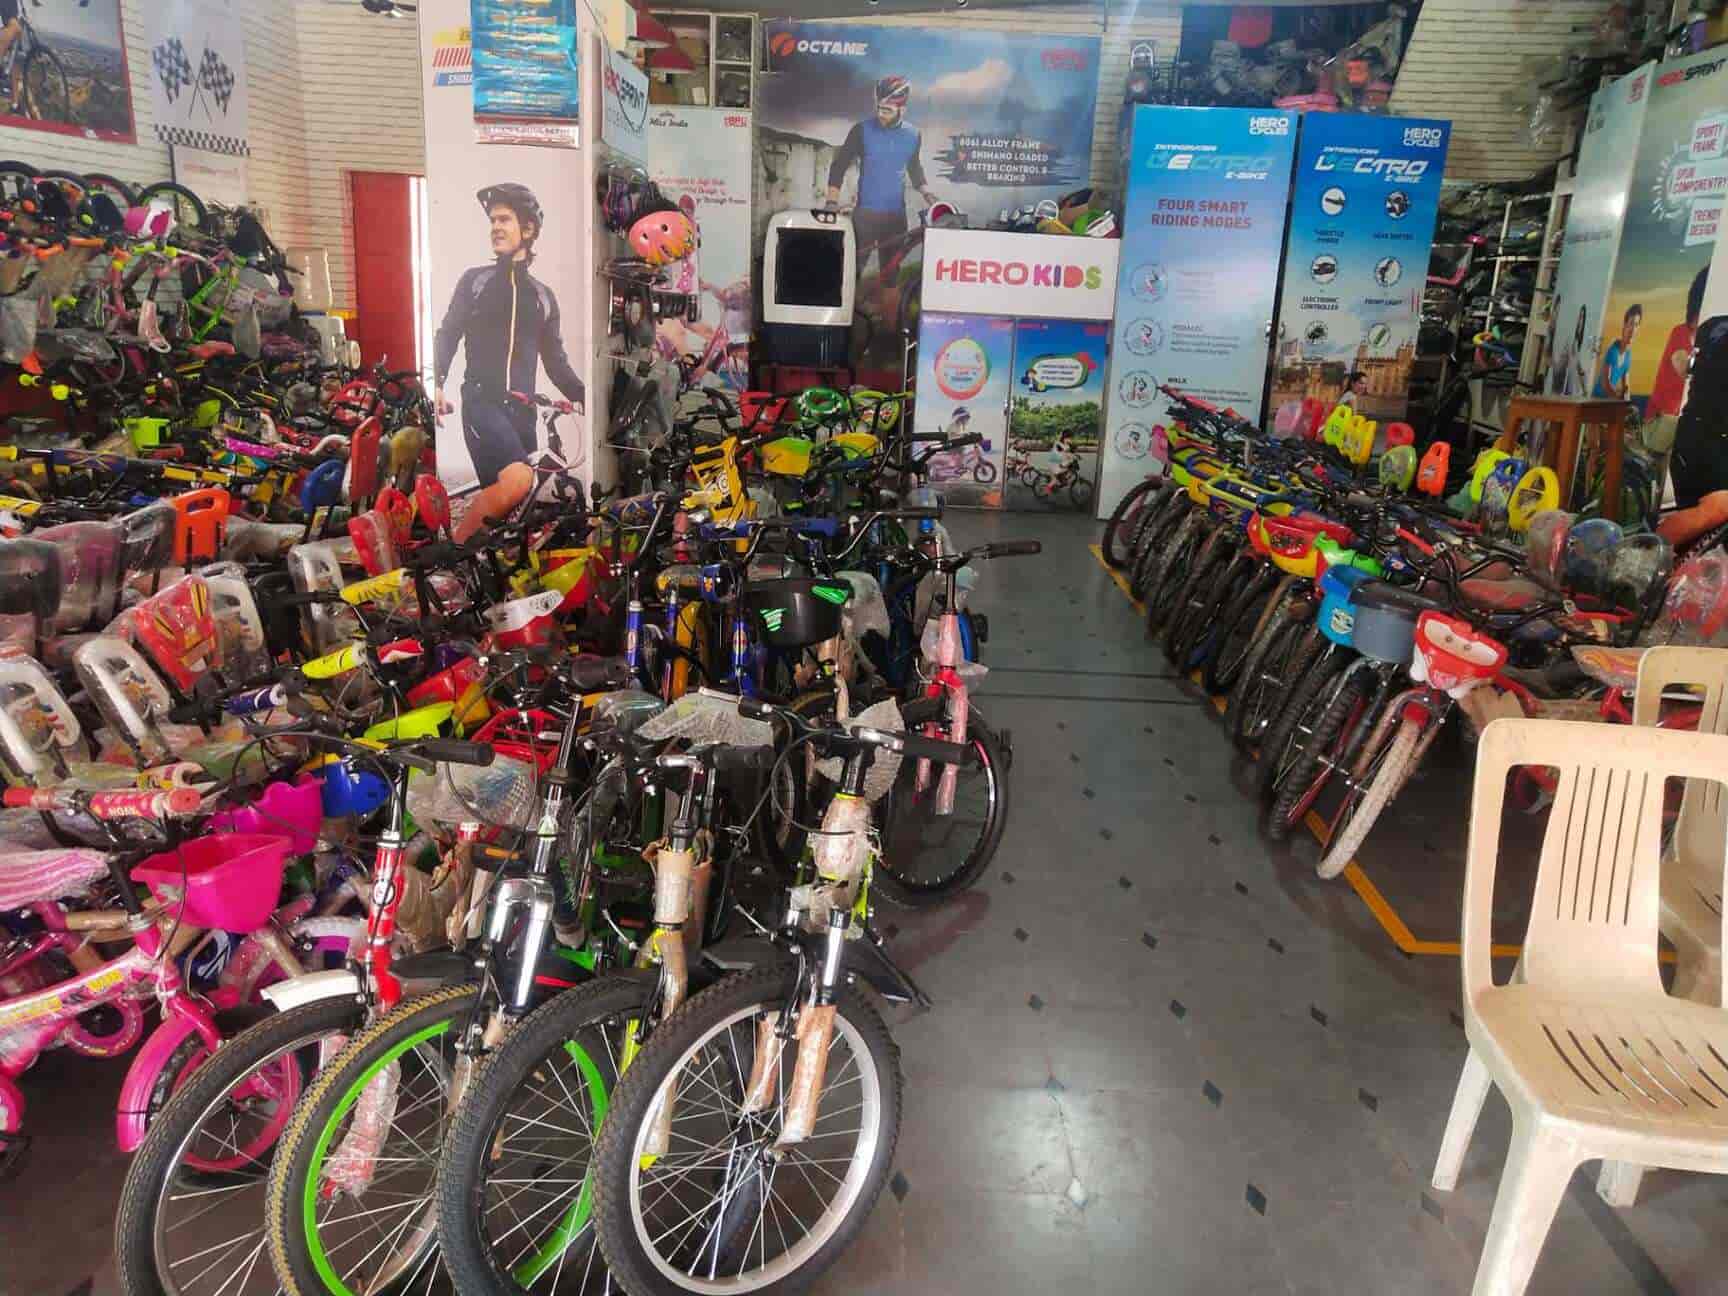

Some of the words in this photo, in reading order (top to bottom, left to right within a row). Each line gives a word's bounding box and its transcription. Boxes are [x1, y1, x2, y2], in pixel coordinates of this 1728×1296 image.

[797, 40, 869, 56] OCTANE
[1250, 116, 1289, 128] HERO
[1249, 127, 1288, 136] CYCLES
[1403, 127, 1442, 140] HERO
[981, 137, 1009, 148] ALLOY
[1011, 139, 1041, 150] FRAME
[1403, 138, 1441, 148] CYCLES
[971, 150, 1013, 161] SHIMANO
[1014, 151, 1049, 162] LOADED
[966, 162, 998, 171] BETTER
[999, 163, 1040, 174] CONTROL
[1313, 154, 1429, 176] LECTRO
[1158, 198, 1195, 211] FOUR
[1199, 199, 1249, 214] SMART
[1151, 212, 1200, 226] RIDING
[1202, 214, 1252, 229] MODES
